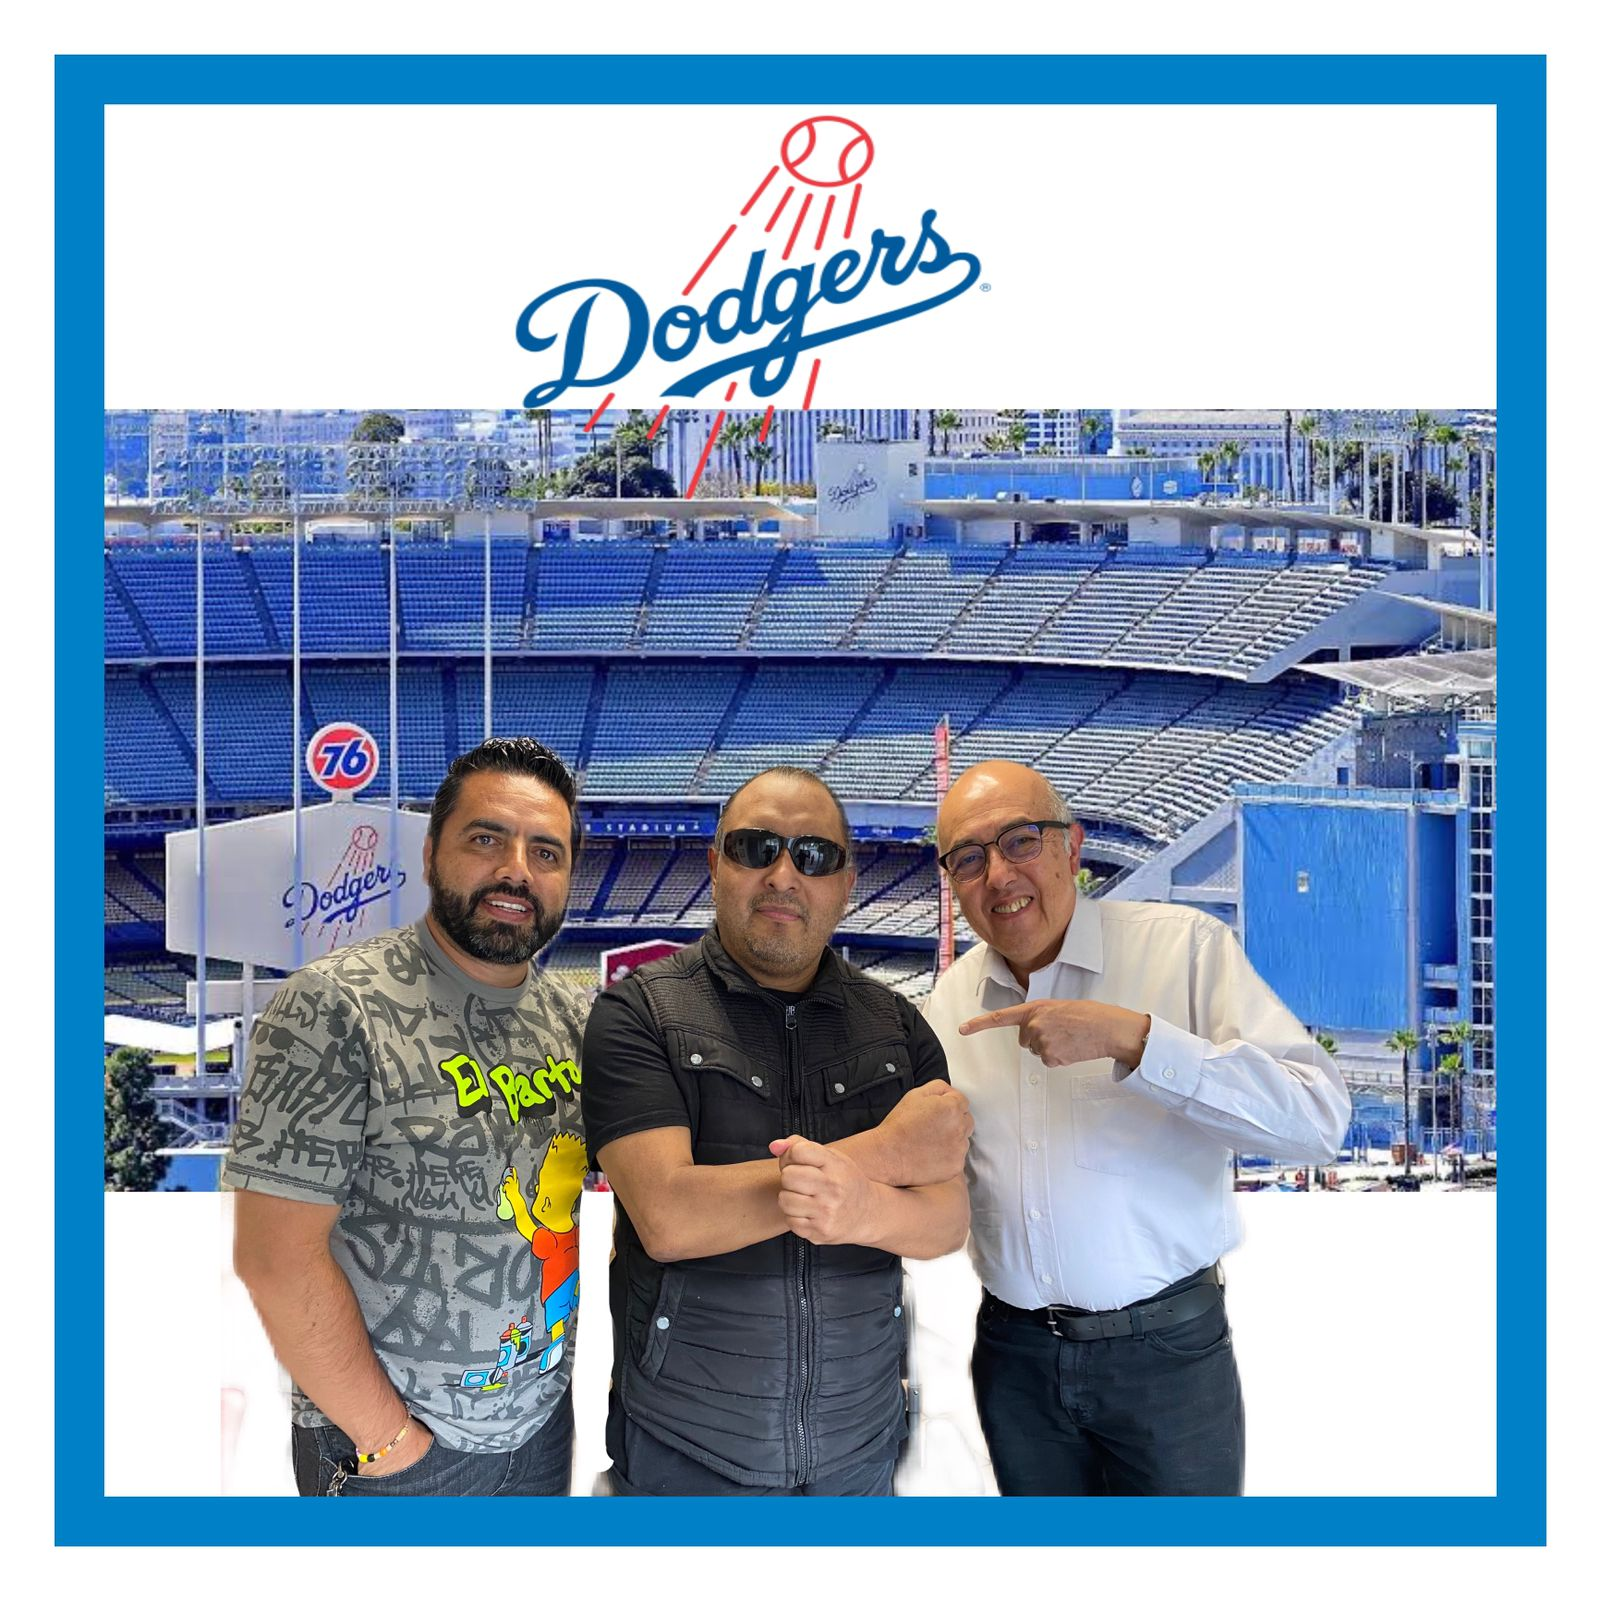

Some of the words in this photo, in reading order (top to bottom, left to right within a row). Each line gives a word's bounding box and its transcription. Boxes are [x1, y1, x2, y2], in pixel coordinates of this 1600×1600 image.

[319, 737, 370, 778] 76
[606, 823, 686, 833] STADIUM
[439, 1053, 490, 1108] El
